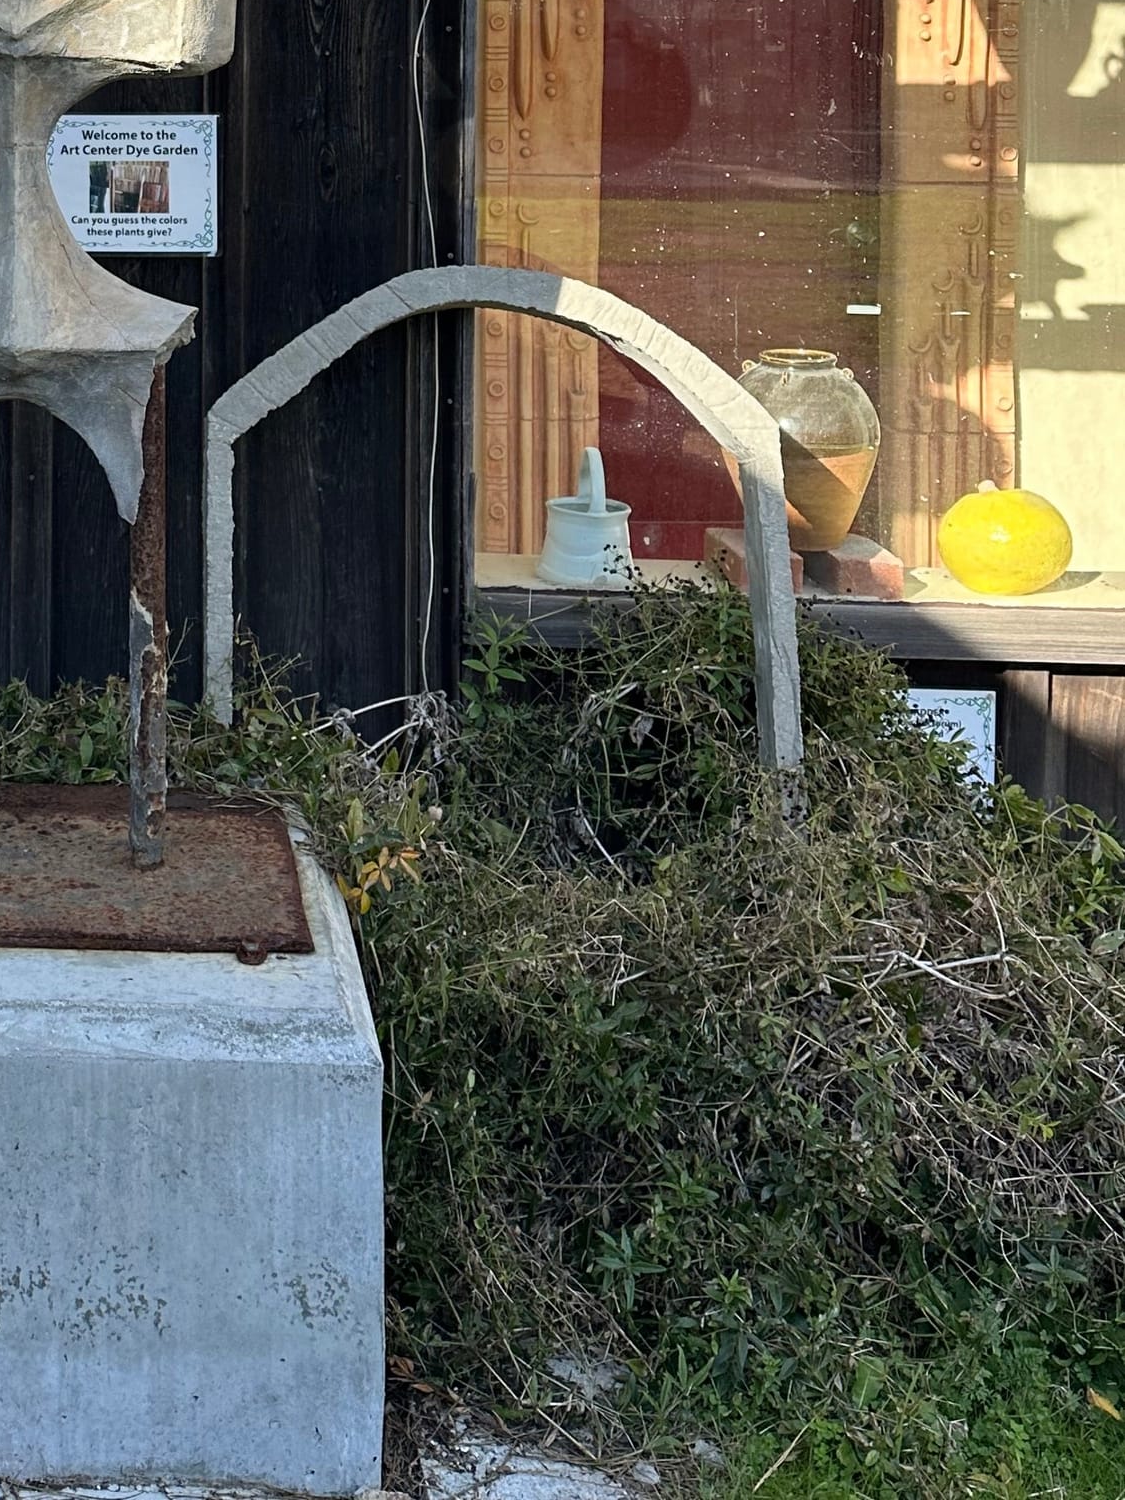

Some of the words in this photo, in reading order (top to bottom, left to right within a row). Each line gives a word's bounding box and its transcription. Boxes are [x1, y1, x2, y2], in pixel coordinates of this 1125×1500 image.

[82, 129, 138, 141] Welcome
[140, 131, 154, 141] to
[156, 129, 177, 141] the
[60, 145, 80, 156] Art
[83, 144, 124, 156] Center
[126, 145, 151, 158] Dye
[153, 144, 199, 156] Garden
[71, 215, 90, 225] Can
[91, 217, 110, 227] you
[111, 217, 139, 227] guess
[141, 215, 157, 225] the
[158, 215, 188, 225] colors
[87, 227, 114, 237] these
[115, 227, 146, 239] plants
[147, 227, 173, 239] give?
